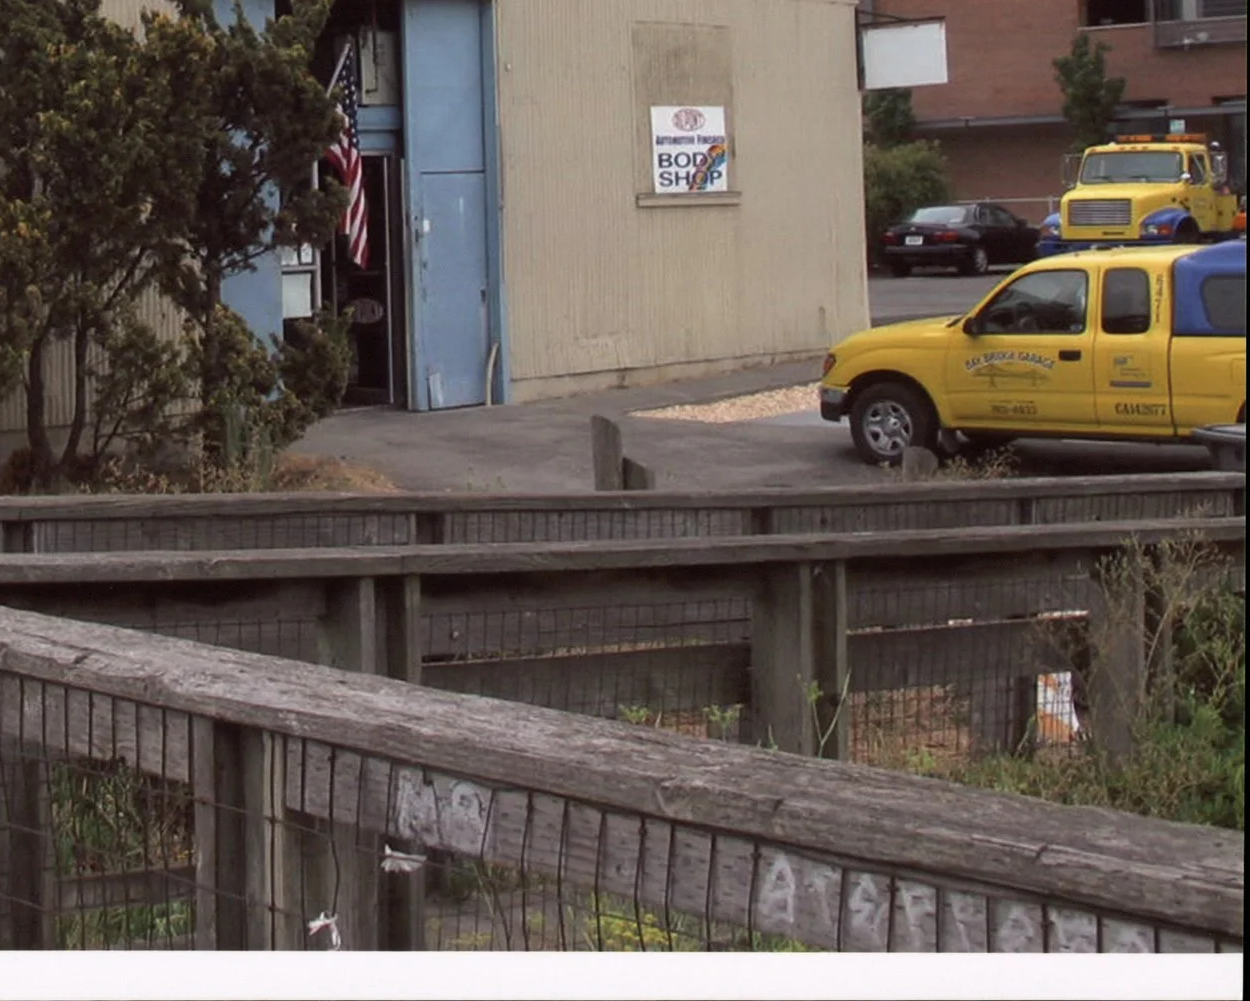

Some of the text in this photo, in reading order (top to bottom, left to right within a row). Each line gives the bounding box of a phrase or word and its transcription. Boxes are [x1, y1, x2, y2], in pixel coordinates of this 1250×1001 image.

[659, 170, 723, 188] SHOP
[982, 351, 1014, 362] BRIDGE
[1017, 352, 1054, 369] GARAGE
